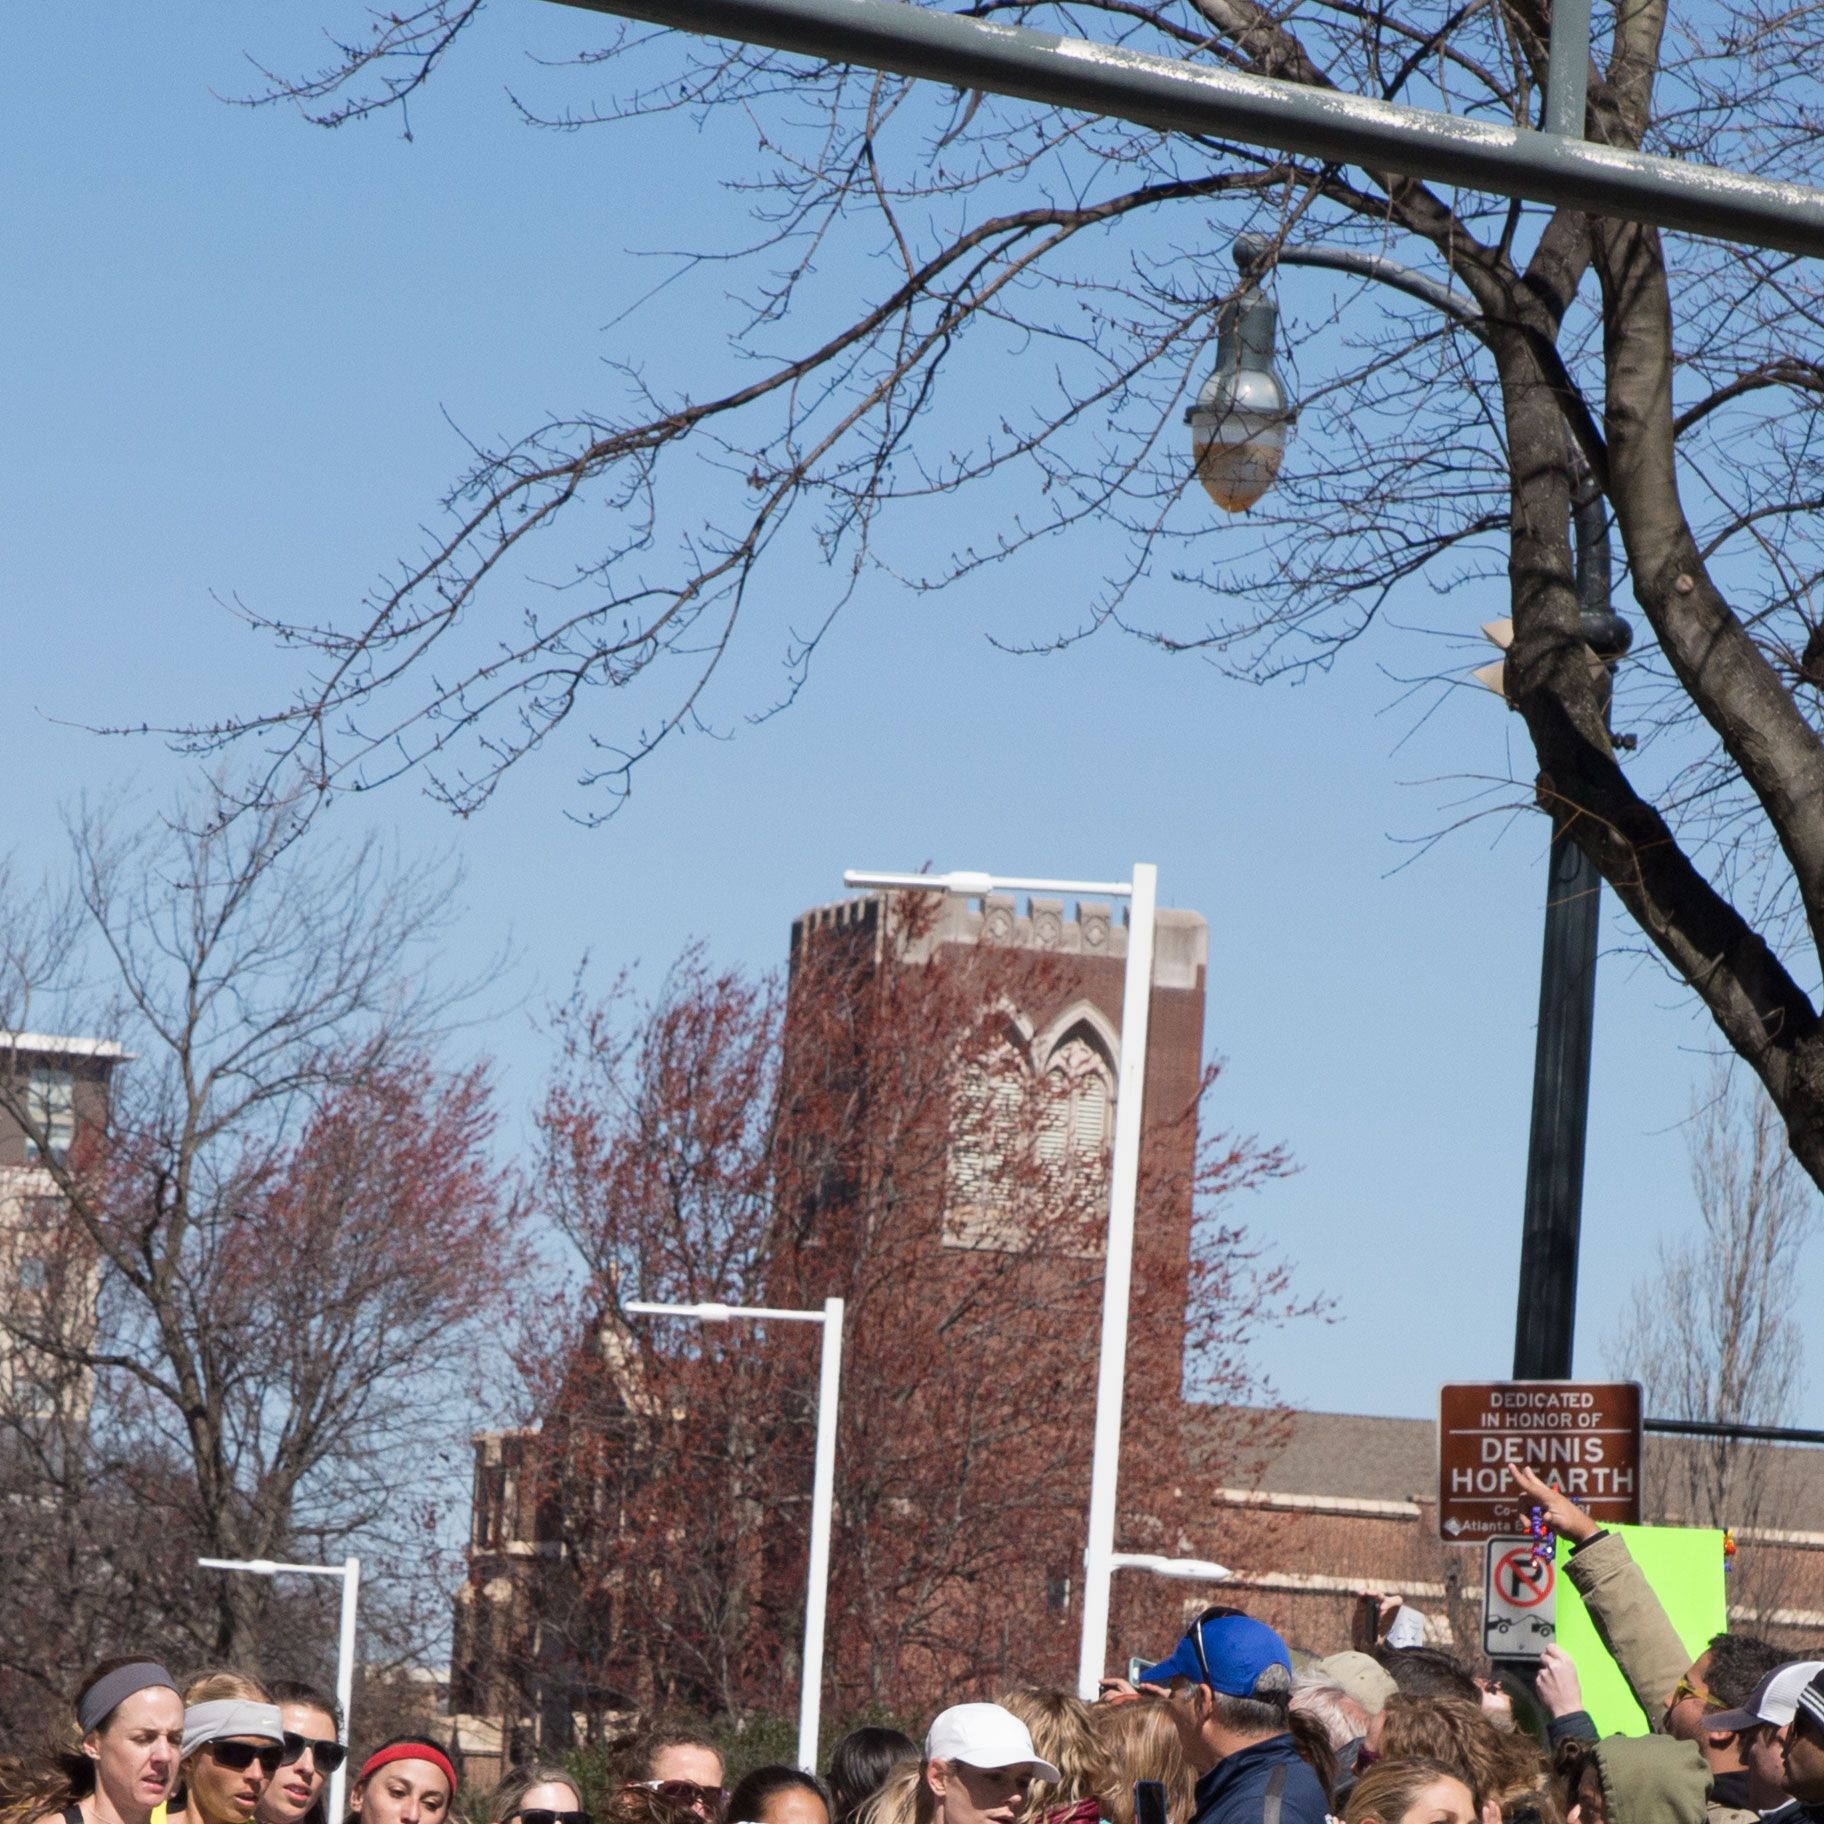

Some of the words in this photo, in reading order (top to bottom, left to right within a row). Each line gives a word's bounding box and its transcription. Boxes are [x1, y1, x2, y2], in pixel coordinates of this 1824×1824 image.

[1490, 1393, 1594, 1408] DEDICATED
[1481, 1413, 1500, 1427] IN
[1505, 1413, 1572, 1428] HONOR
[1578, 1413, 1603, 1427] OF
[1481, 1437, 1605, 1463] DENNIS
[1462, 1519, 1511, 1532] Atlanta
